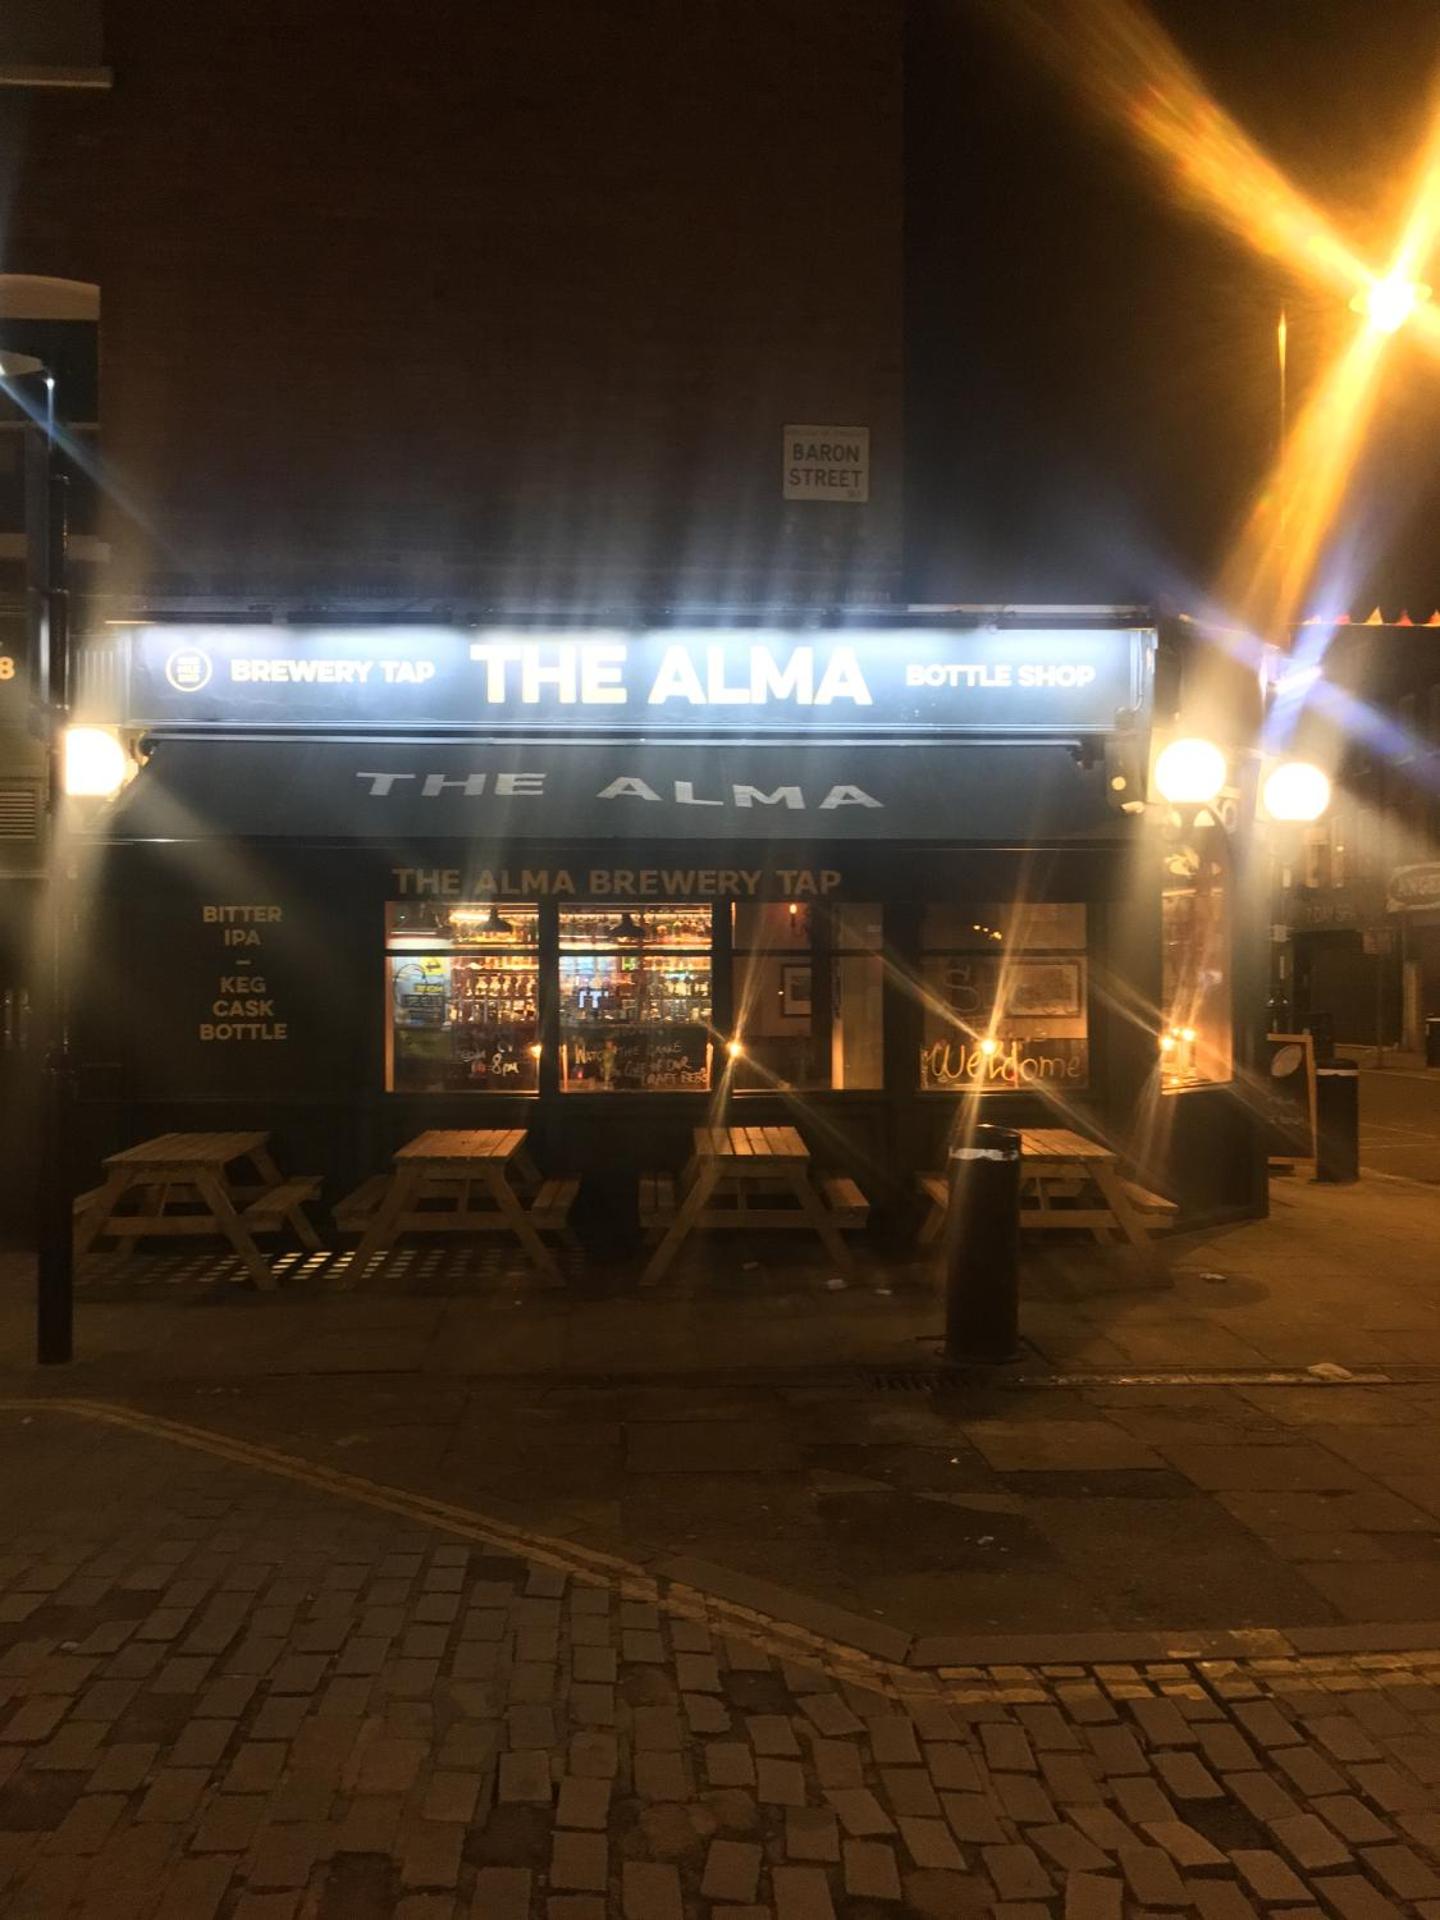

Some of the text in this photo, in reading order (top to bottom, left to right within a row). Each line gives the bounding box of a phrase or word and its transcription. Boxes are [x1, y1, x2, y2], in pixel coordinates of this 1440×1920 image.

[793, 443, 860, 462] BARON
[789, 469, 863, 488] STREET
[231, 659, 435, 683] BREWERY TAP
[470, 644, 873, 705] THE ALMA
[905, 664, 1096, 687] BOTTLE SHOP
[355, 772, 885, 810] THE ALMA
[393, 868, 842, 895] THE ALMA BREWERY TAP
[202, 905, 283, 923] BITTER
[224, 928, 262, 946] IPA
[220, 976, 267, 994] KEG
[212, 1000, 275, 1017] CASK
[200, 1023, 288, 1041] BOTTLE
